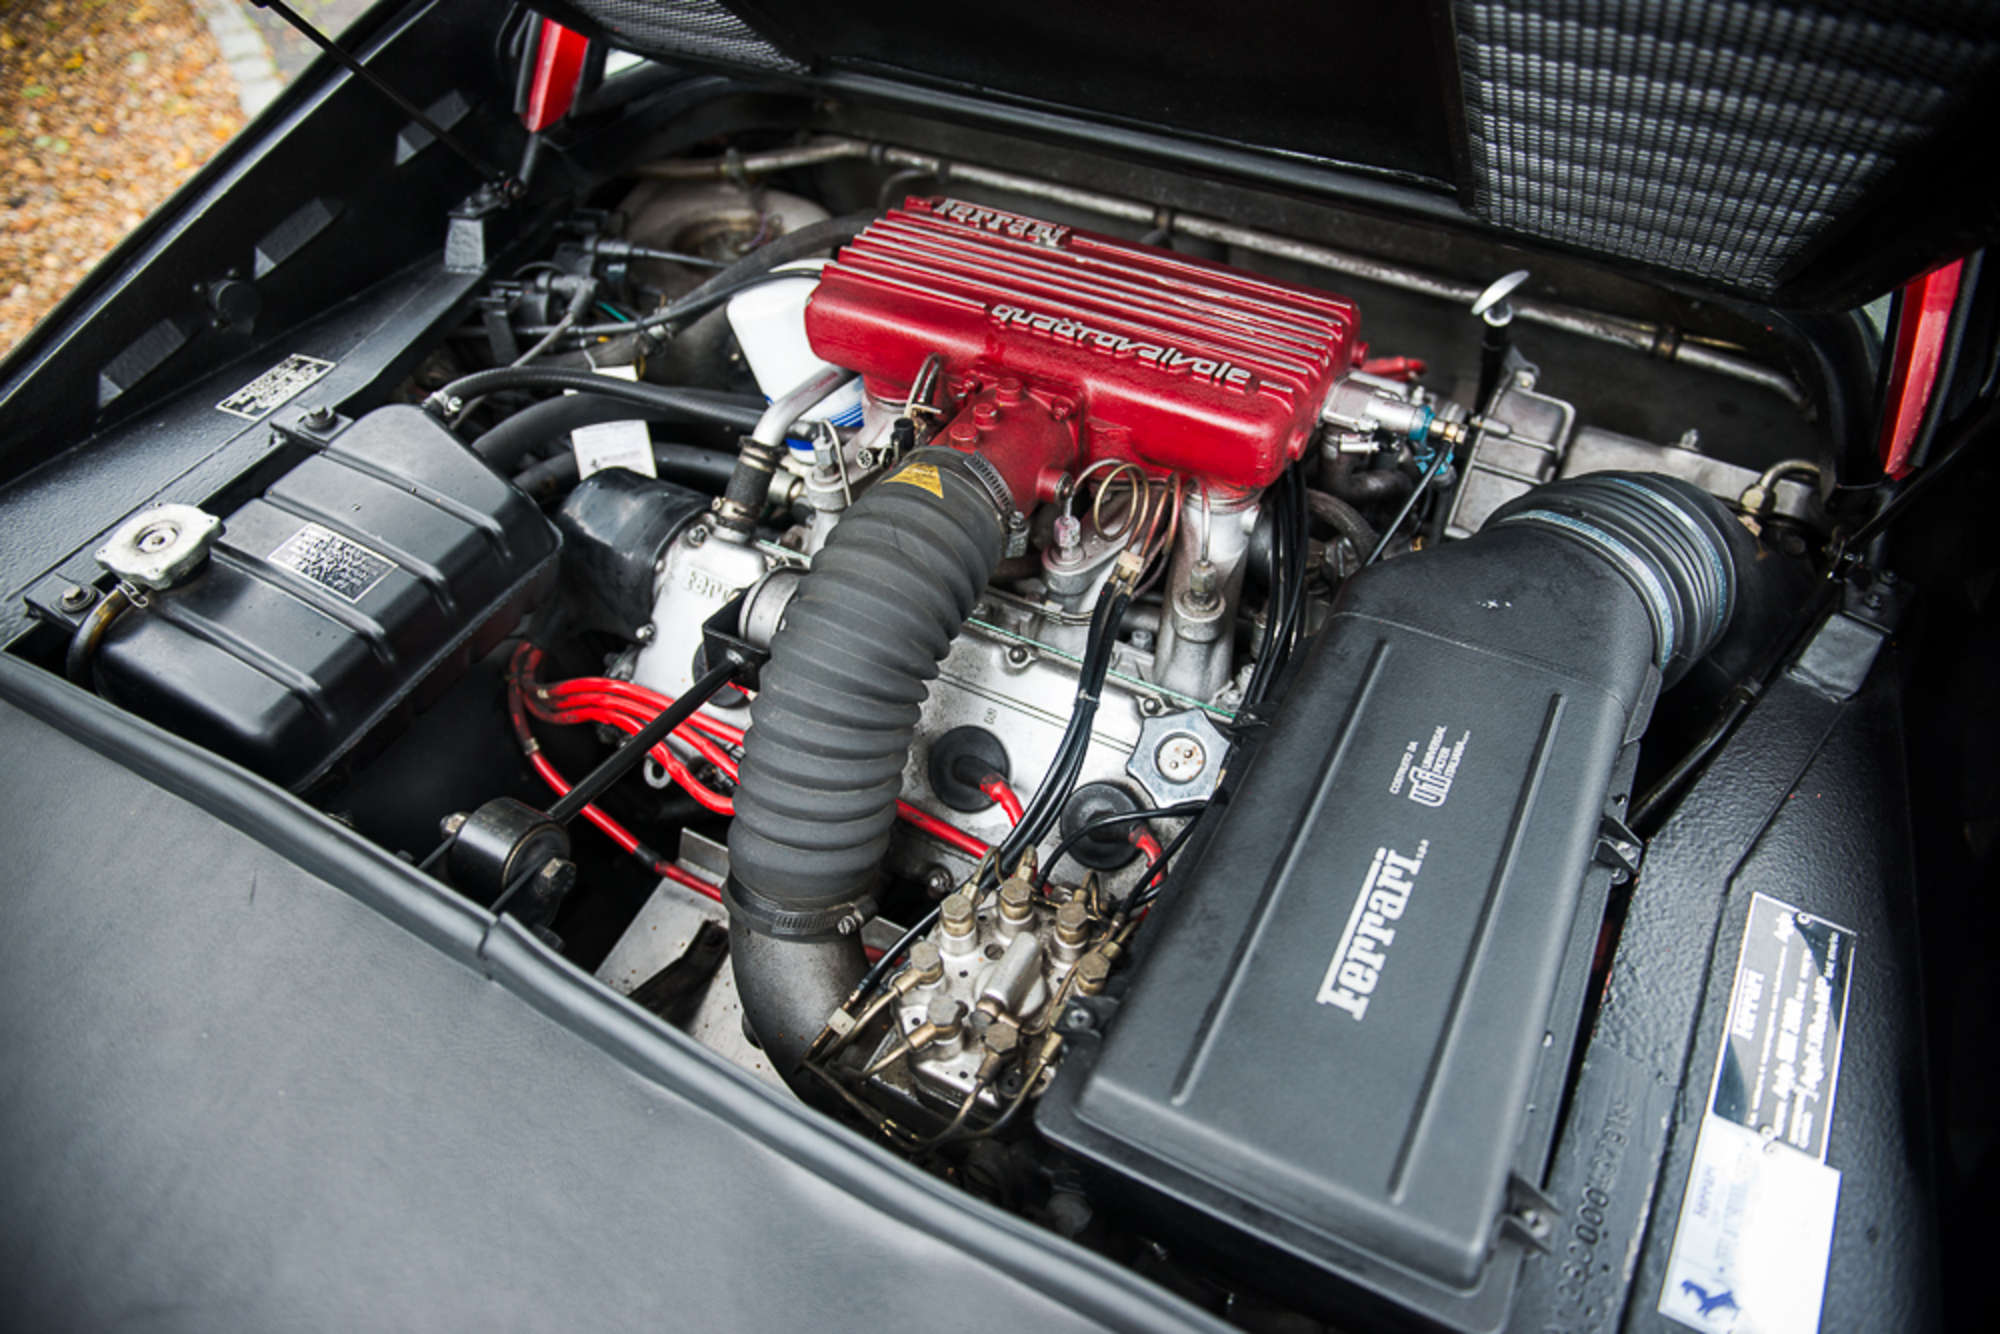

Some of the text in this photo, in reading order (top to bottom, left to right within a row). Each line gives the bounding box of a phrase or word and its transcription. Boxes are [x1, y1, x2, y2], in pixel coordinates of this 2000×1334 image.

[932, 198, 1071, 248] Ferrari
[991, 303, 1252, 386] quattrovalvole
[1316, 846, 1423, 1021] Ferrari
